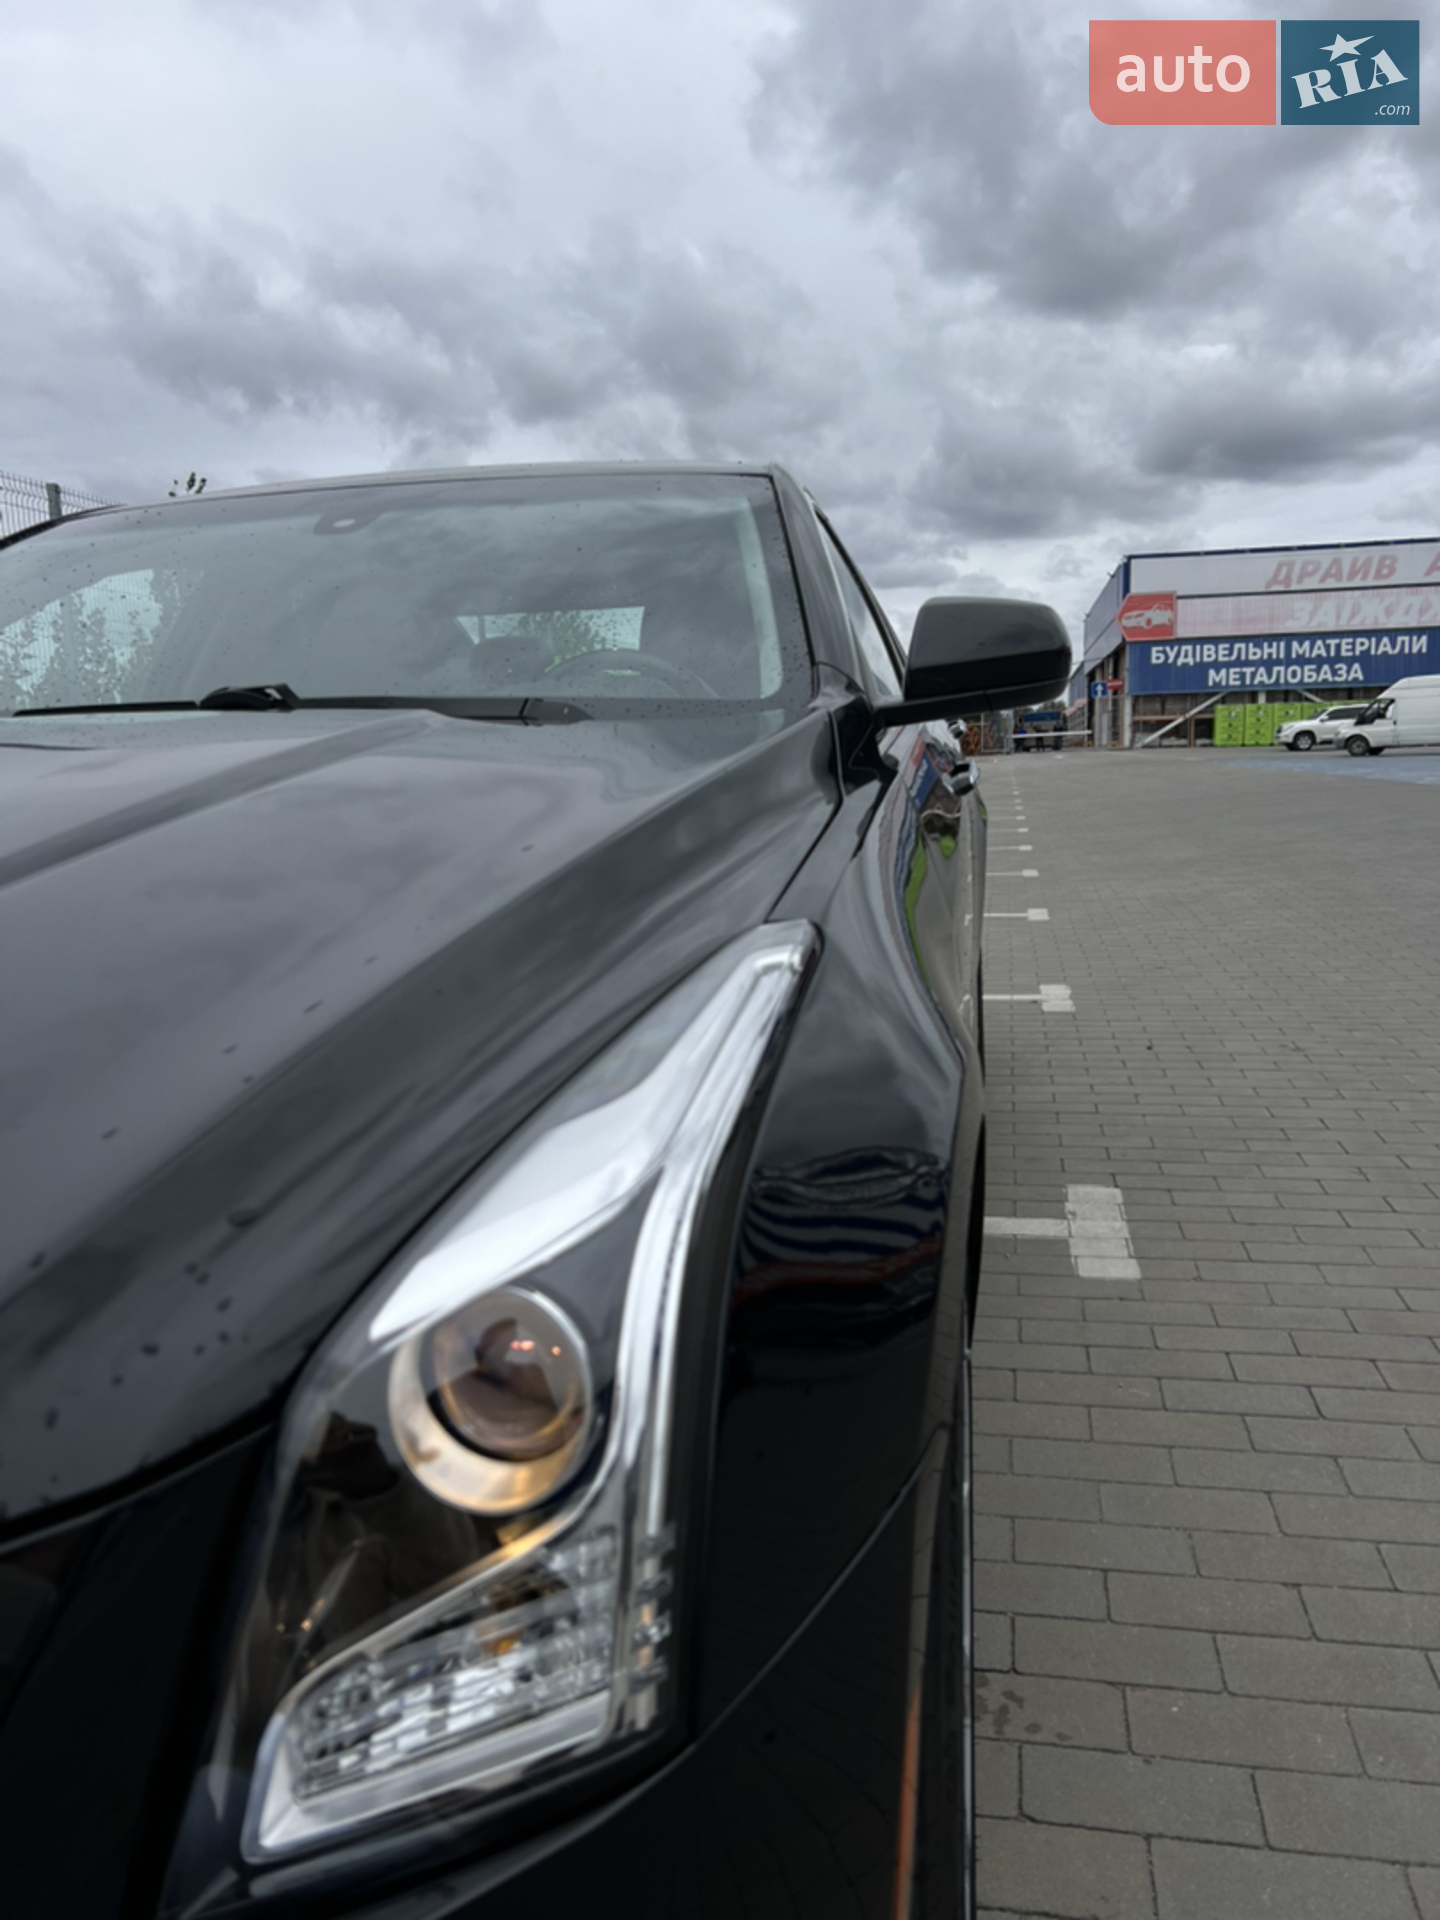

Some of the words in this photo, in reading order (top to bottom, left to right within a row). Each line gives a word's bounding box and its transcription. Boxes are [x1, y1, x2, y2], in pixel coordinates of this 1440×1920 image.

[1151, 640, 1285, 667] БУДІВЕЛЬНІ
[1291, 634, 1428, 658] МАТЕРІАЛИ
[1208, 662, 1364, 687] МЕТАЛОБАЗА
